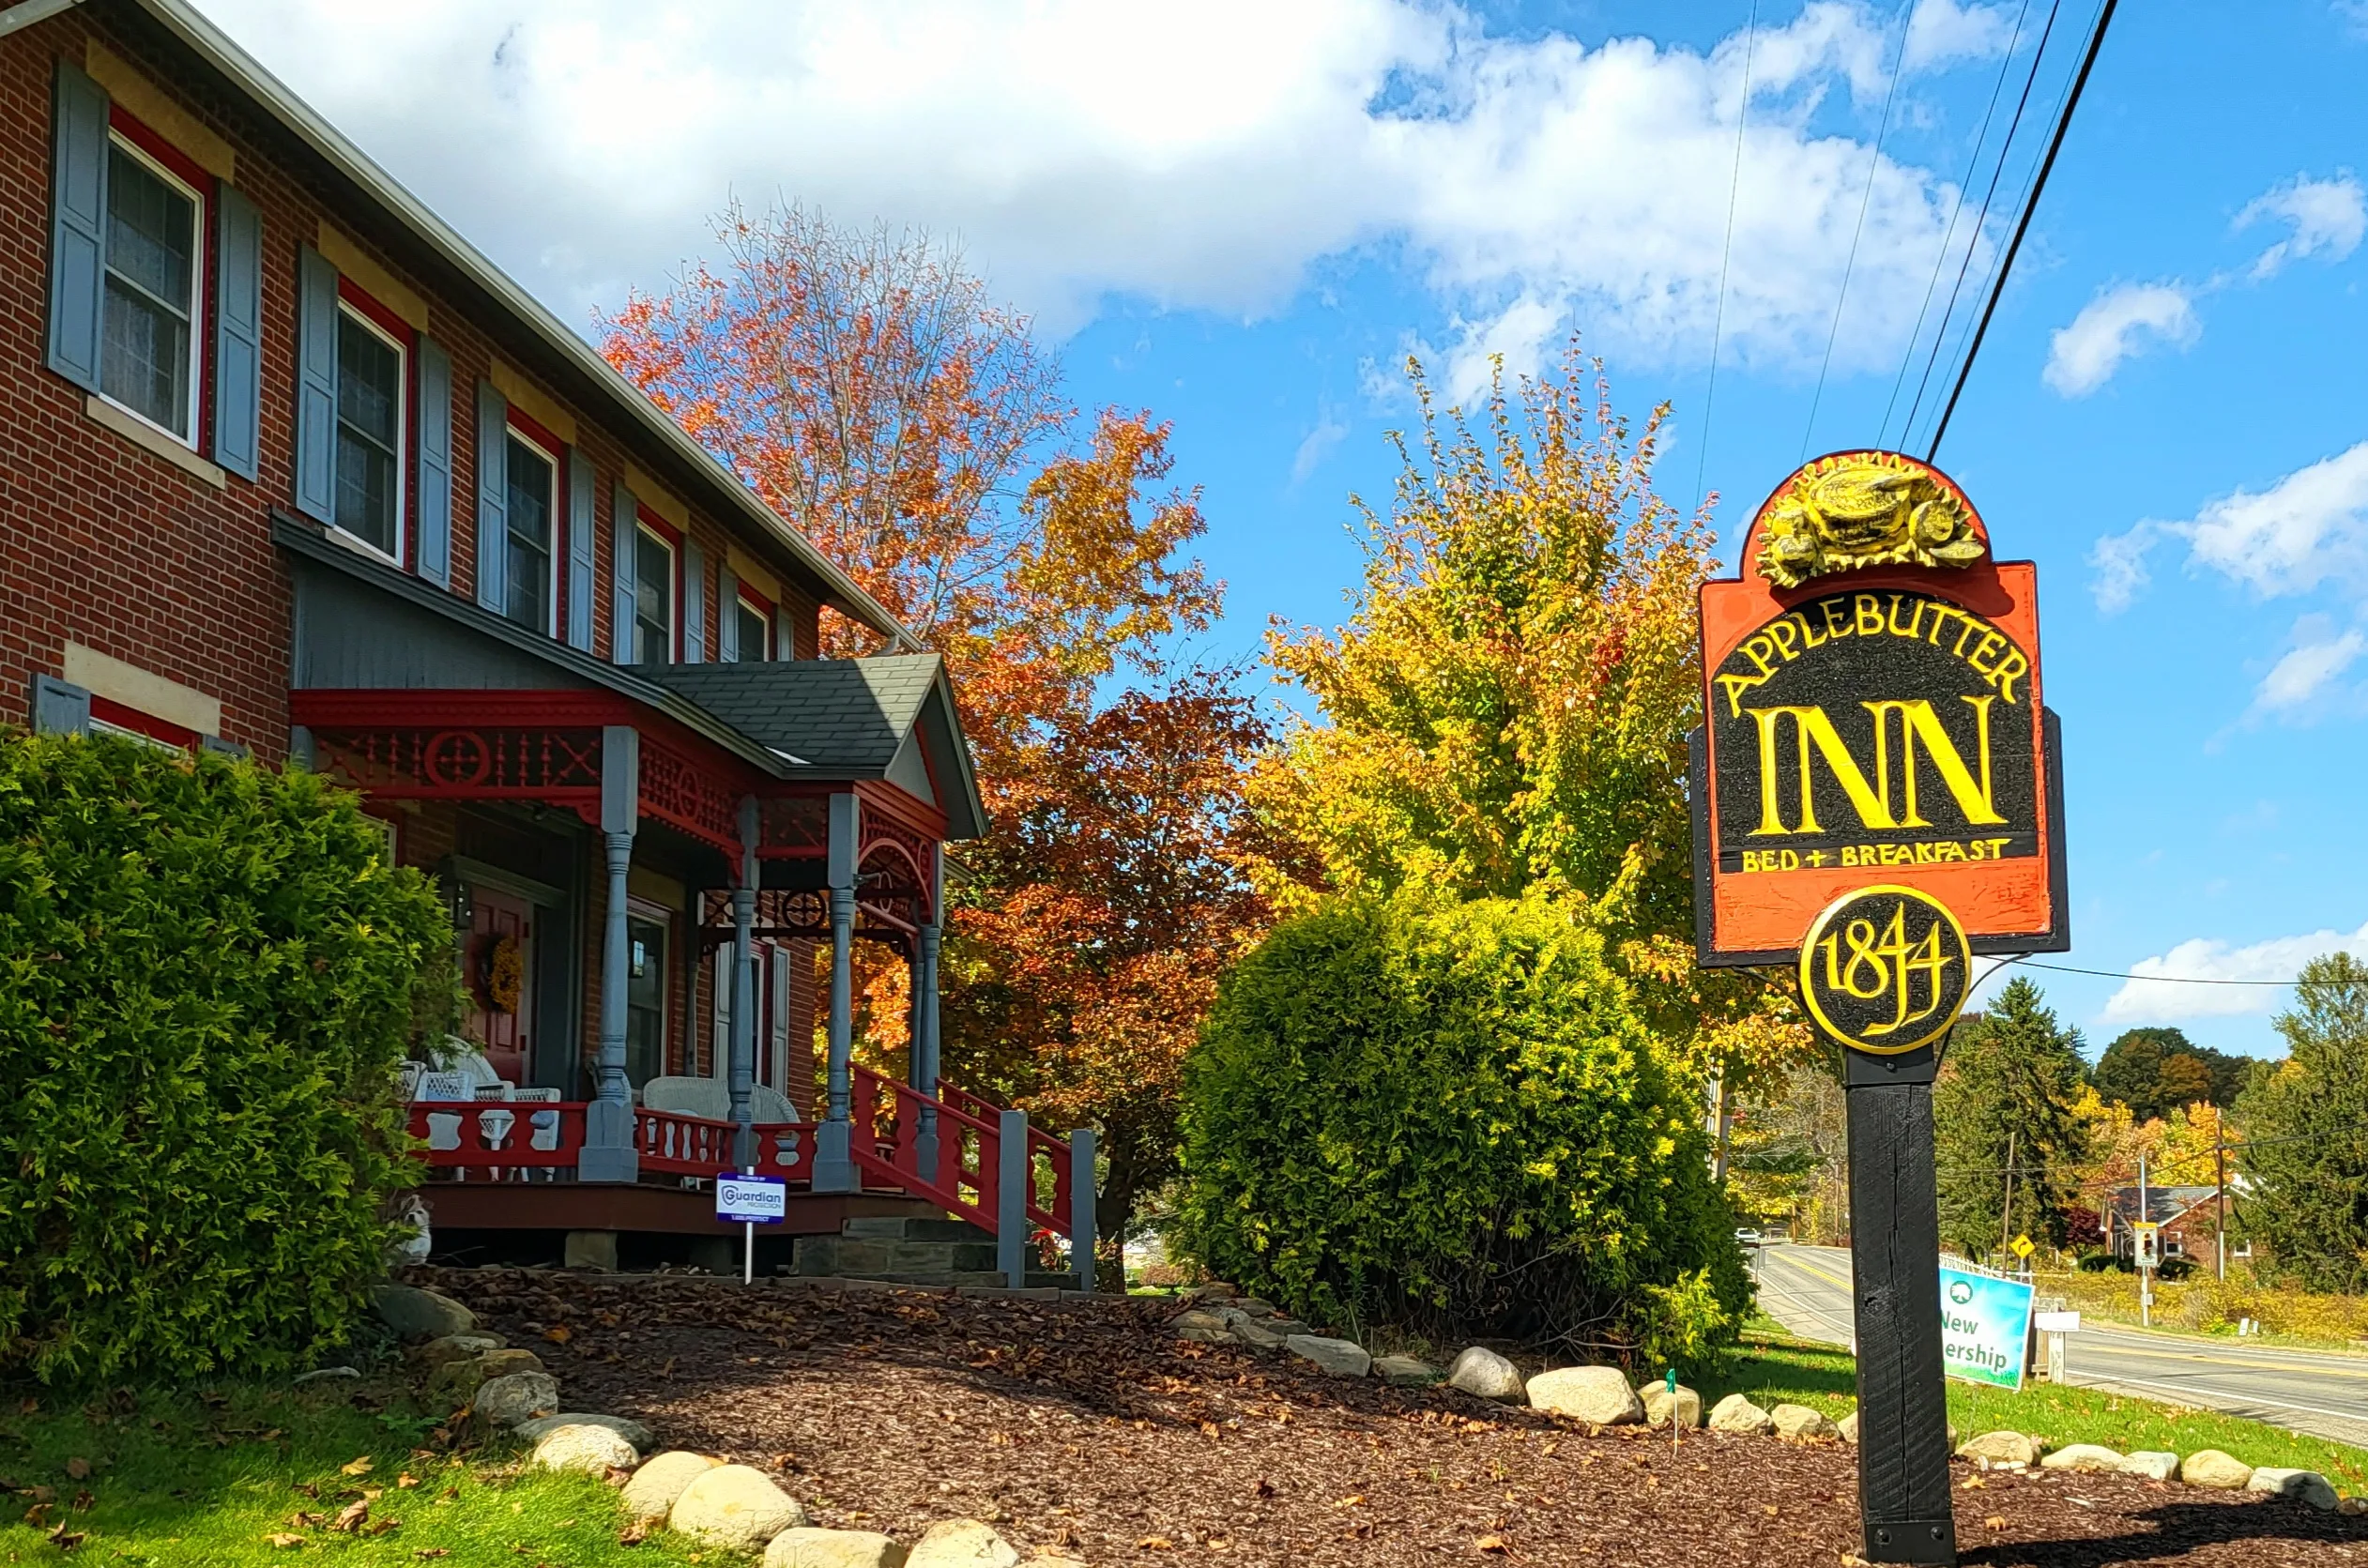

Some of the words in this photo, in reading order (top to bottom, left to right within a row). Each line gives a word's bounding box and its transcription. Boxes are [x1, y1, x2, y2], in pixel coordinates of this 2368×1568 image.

[1716, 594, 2028, 719] APPLEBUTTER
[1745, 695, 2009, 836] INN
[1743, 849, 1799, 873] BED
[1841, 838, 2012, 867] BREAKFAST
[1815, 901, 1957, 1037] 1844
[725, 1189, 781, 1203] Guardian
[1945, 1343, 2008, 1372] ership
